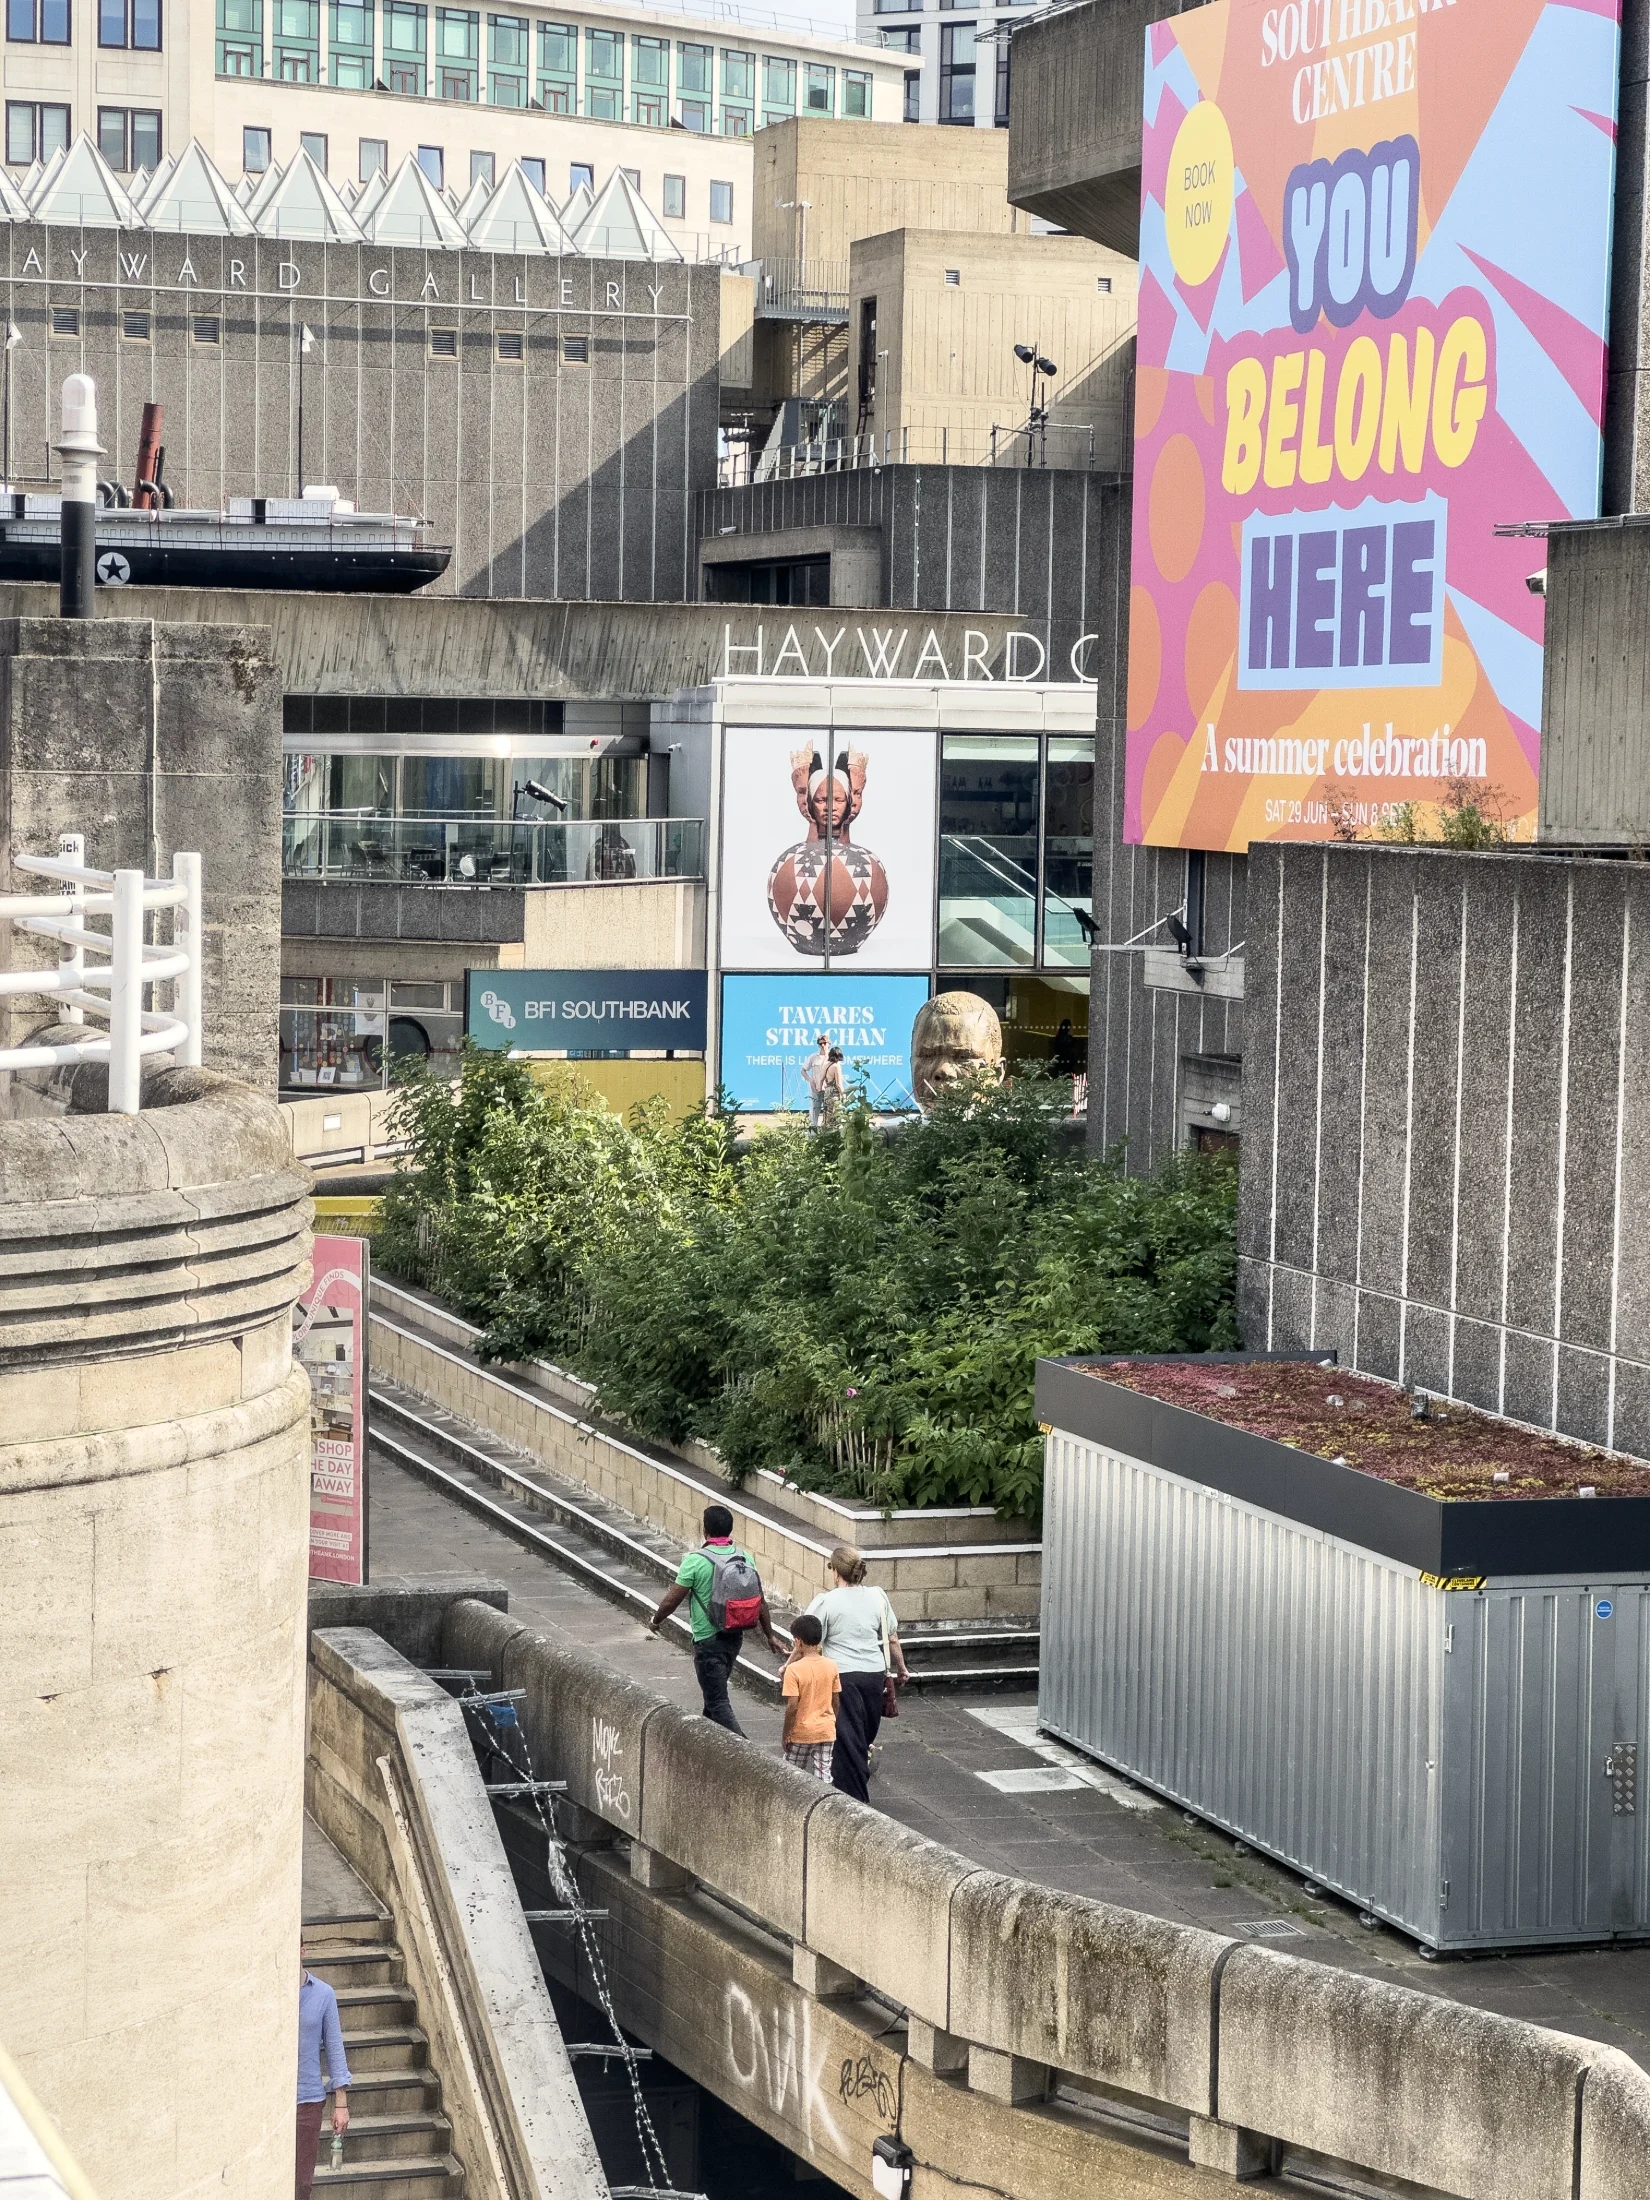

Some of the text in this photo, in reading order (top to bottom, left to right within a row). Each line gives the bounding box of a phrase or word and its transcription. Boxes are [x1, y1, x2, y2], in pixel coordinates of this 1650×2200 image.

[1261, 0, 1457, 67] SOUTHB
[1292, 31, 1417, 125] CENTRE
[1184, 160, 1216, 191] BOOK
[1185, 199, 1212, 228] NOW
[1290, 158, 1411, 311] YOU
[369, 269, 664, 310] GALLERY
[1221, 316, 1489, 495] BELONG
[1248, 519, 1436, 670] HERE
[724, 623, 1046, 682] HAYWARD
[1201, 723, 1488, 778] A summer celebration
[1265, 799, 1287, 824] SAT
[1288, 800, 1302, 824] 29
[1303, 801, 1328, 825] JUN
[1342, 801, 1368, 826] SUN
[1370, 802, 1378, 827] 8
[524, 1000, 556, 1019] BFI
[562, 1000, 691, 1020] SOUTHBANK
[779, 1006, 874, 1025] TAVARES
[746, 1055, 783, 1066] THERE
[785, 1055, 796, 1066] IS
[843, 1055, 903, 1066] OMEWHERE
[308, 1285, 326, 1321] UNIQUE
[324, 1271, 345, 1286] FINDS
[318, 1441, 352, 1457] SHOP
[314, 1477, 352, 1494] AWAY
[327, 1460, 352, 1475] DAY
